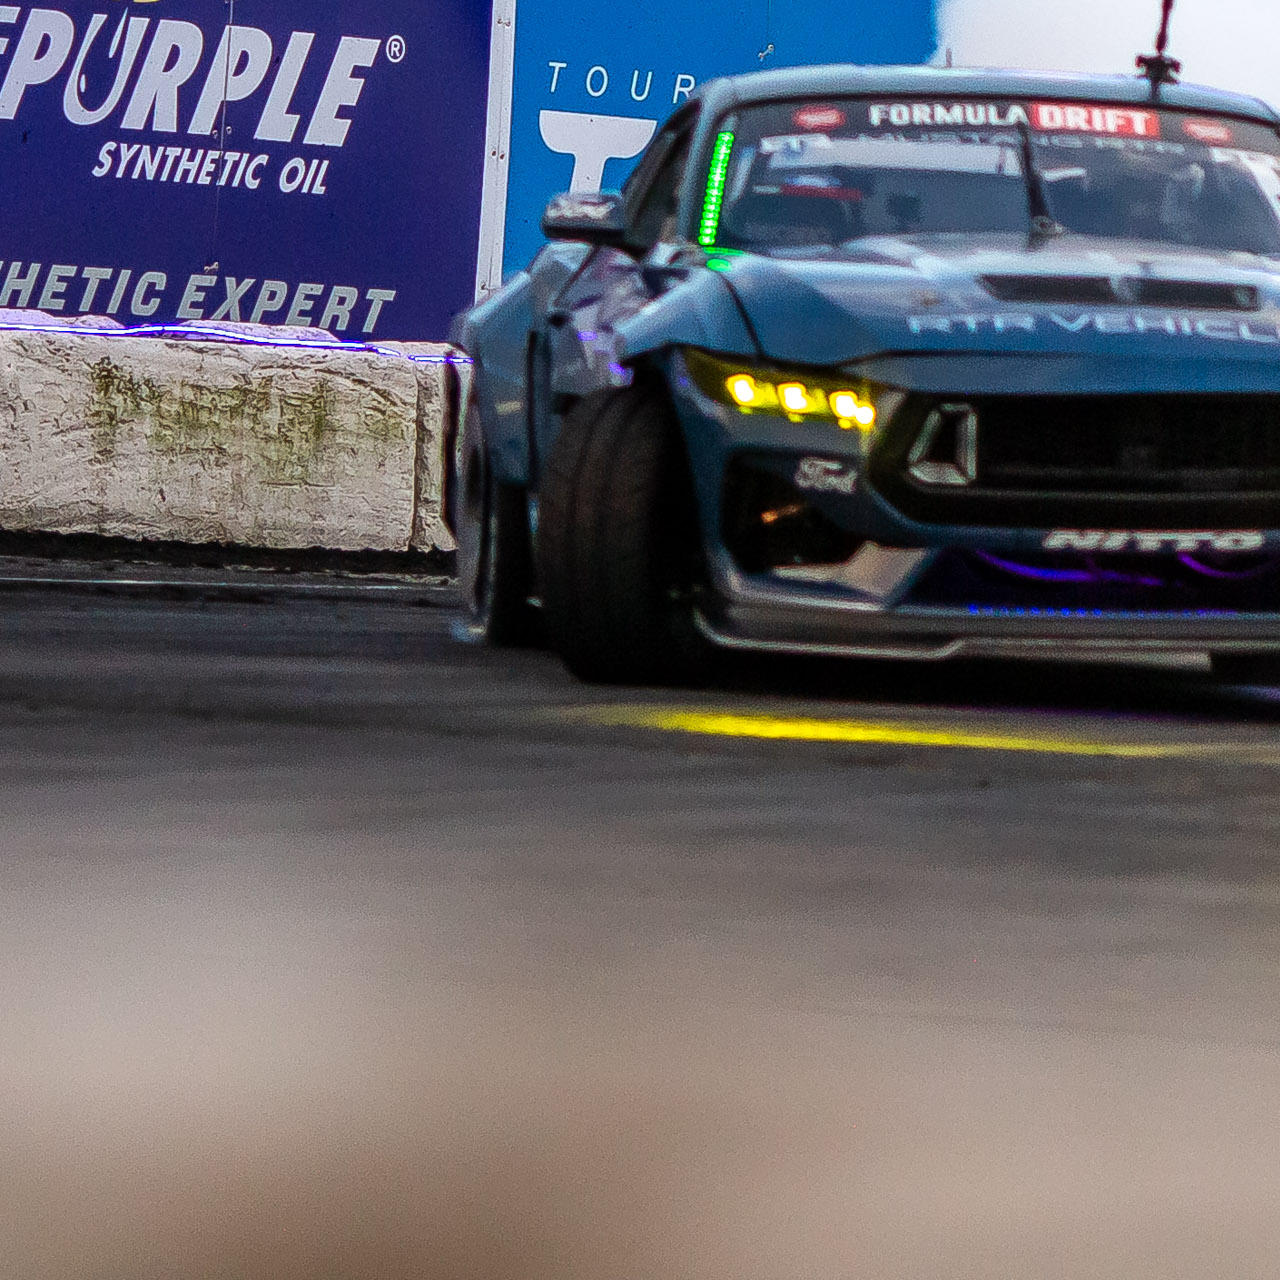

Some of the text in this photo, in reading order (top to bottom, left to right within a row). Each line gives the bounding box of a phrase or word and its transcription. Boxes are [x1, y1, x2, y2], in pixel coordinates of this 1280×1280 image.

[868, 104, 1027, 127] FORMULA
[1037, 104, 1153, 135] DRIFT
[92, 141, 329, 194] SYNTHETIC OIL
[175, 273, 396, 333] EXPERT
[908, 310, 1035, 333] RTR
[1043, 528, 1265, 552] NITTO
